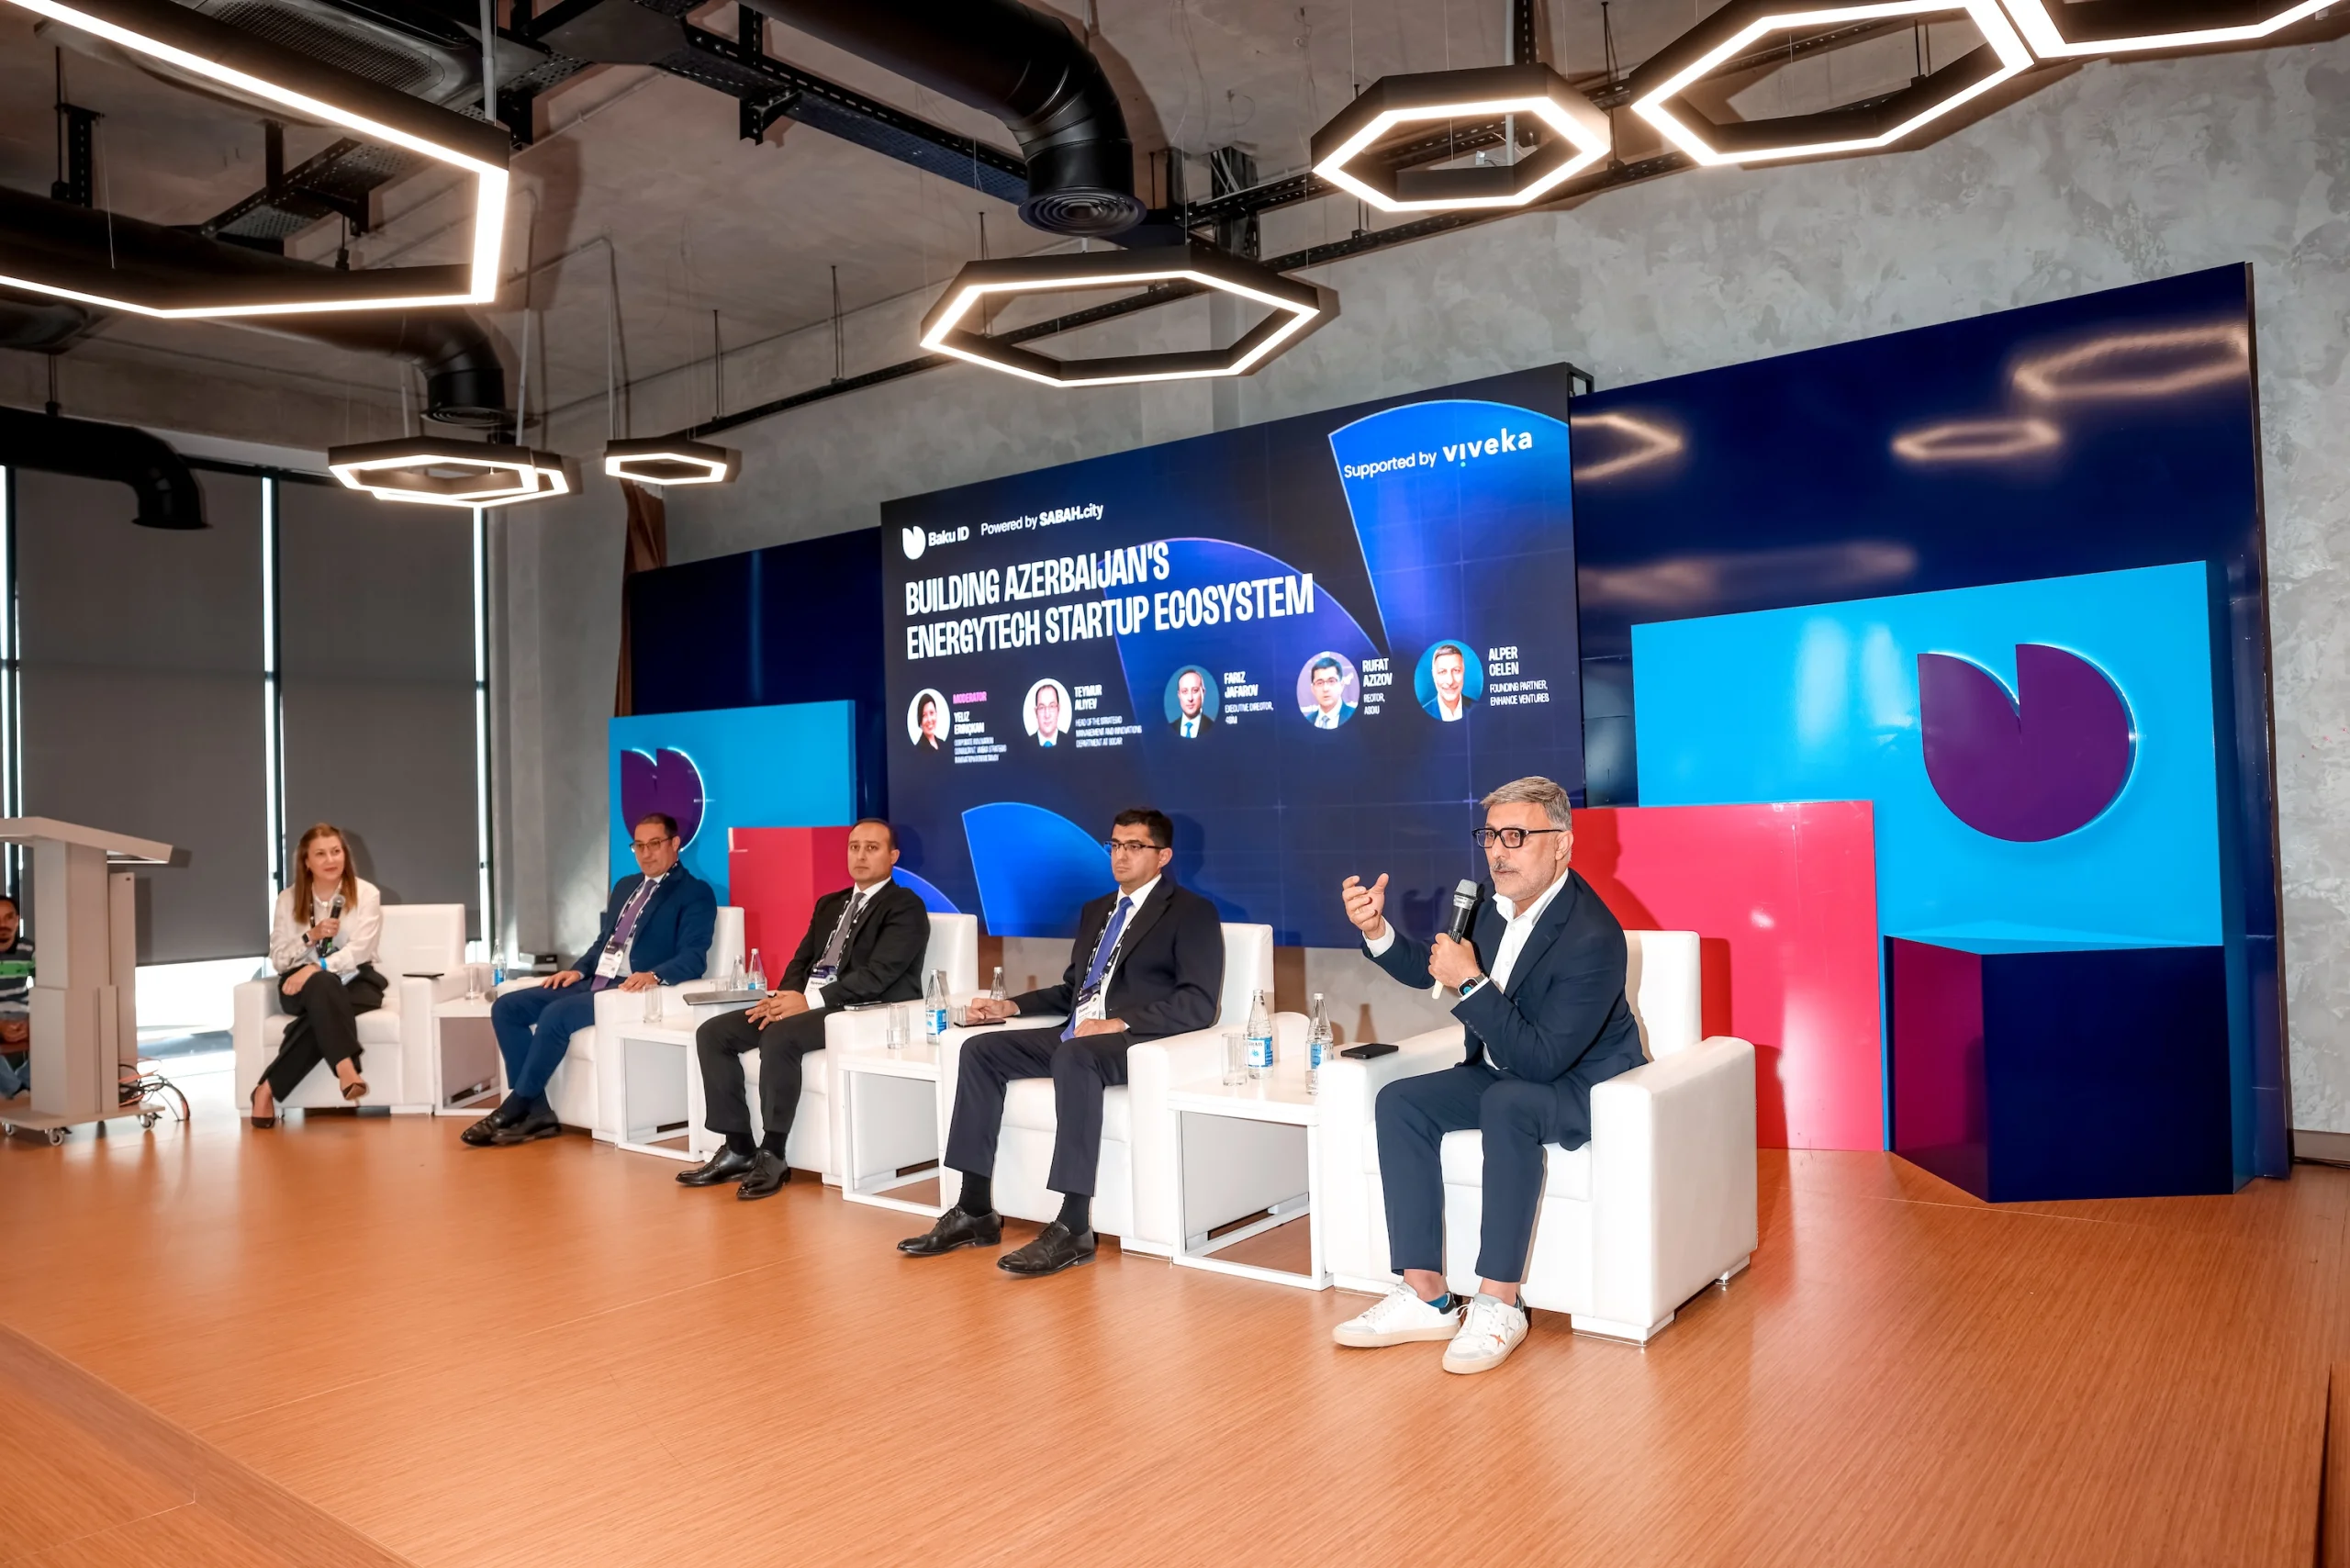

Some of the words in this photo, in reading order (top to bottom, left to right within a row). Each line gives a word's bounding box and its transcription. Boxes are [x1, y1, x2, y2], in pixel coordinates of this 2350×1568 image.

[1343, 454, 1416, 480] Supported
[1419, 451, 1438, 468] by
[1442, 427, 1533, 468] viveka
[980, 516, 1024, 536] Powered
[1024, 515, 1038, 531] by
[1039, 502, 1104, 527] SABAH.city
[928, 530, 956, 547] Baku
[957, 525, 970, 542] ID
[905, 567, 1001, 616] BUILDING
[1003, 541, 1170, 601] AZERBAIJAN'S
[905, 608, 1041, 660] ENERGYTECH
[1045, 595, 1150, 644] STARTUP
[1154, 572, 1315, 632] ECOSYSTEM
[1488, 645, 1518, 661] ALPER
[1361, 657, 1389, 673] RUFAT
[1224, 671, 1246, 685] FARIZ
[1362, 672, 1393, 687] AZIZOV
[1073, 684, 1102, 698] TEYMUR
[1225, 684, 1259, 698] JAFAROV
[1489, 681, 1520, 693] FOUNDING
[953, 691, 988, 704] MODERATOR
[1074, 698, 1098, 711] ALIYEV
[1490, 695, 1518, 707] ENHANCE
[1518, 692, 1550, 705] VENTURES
